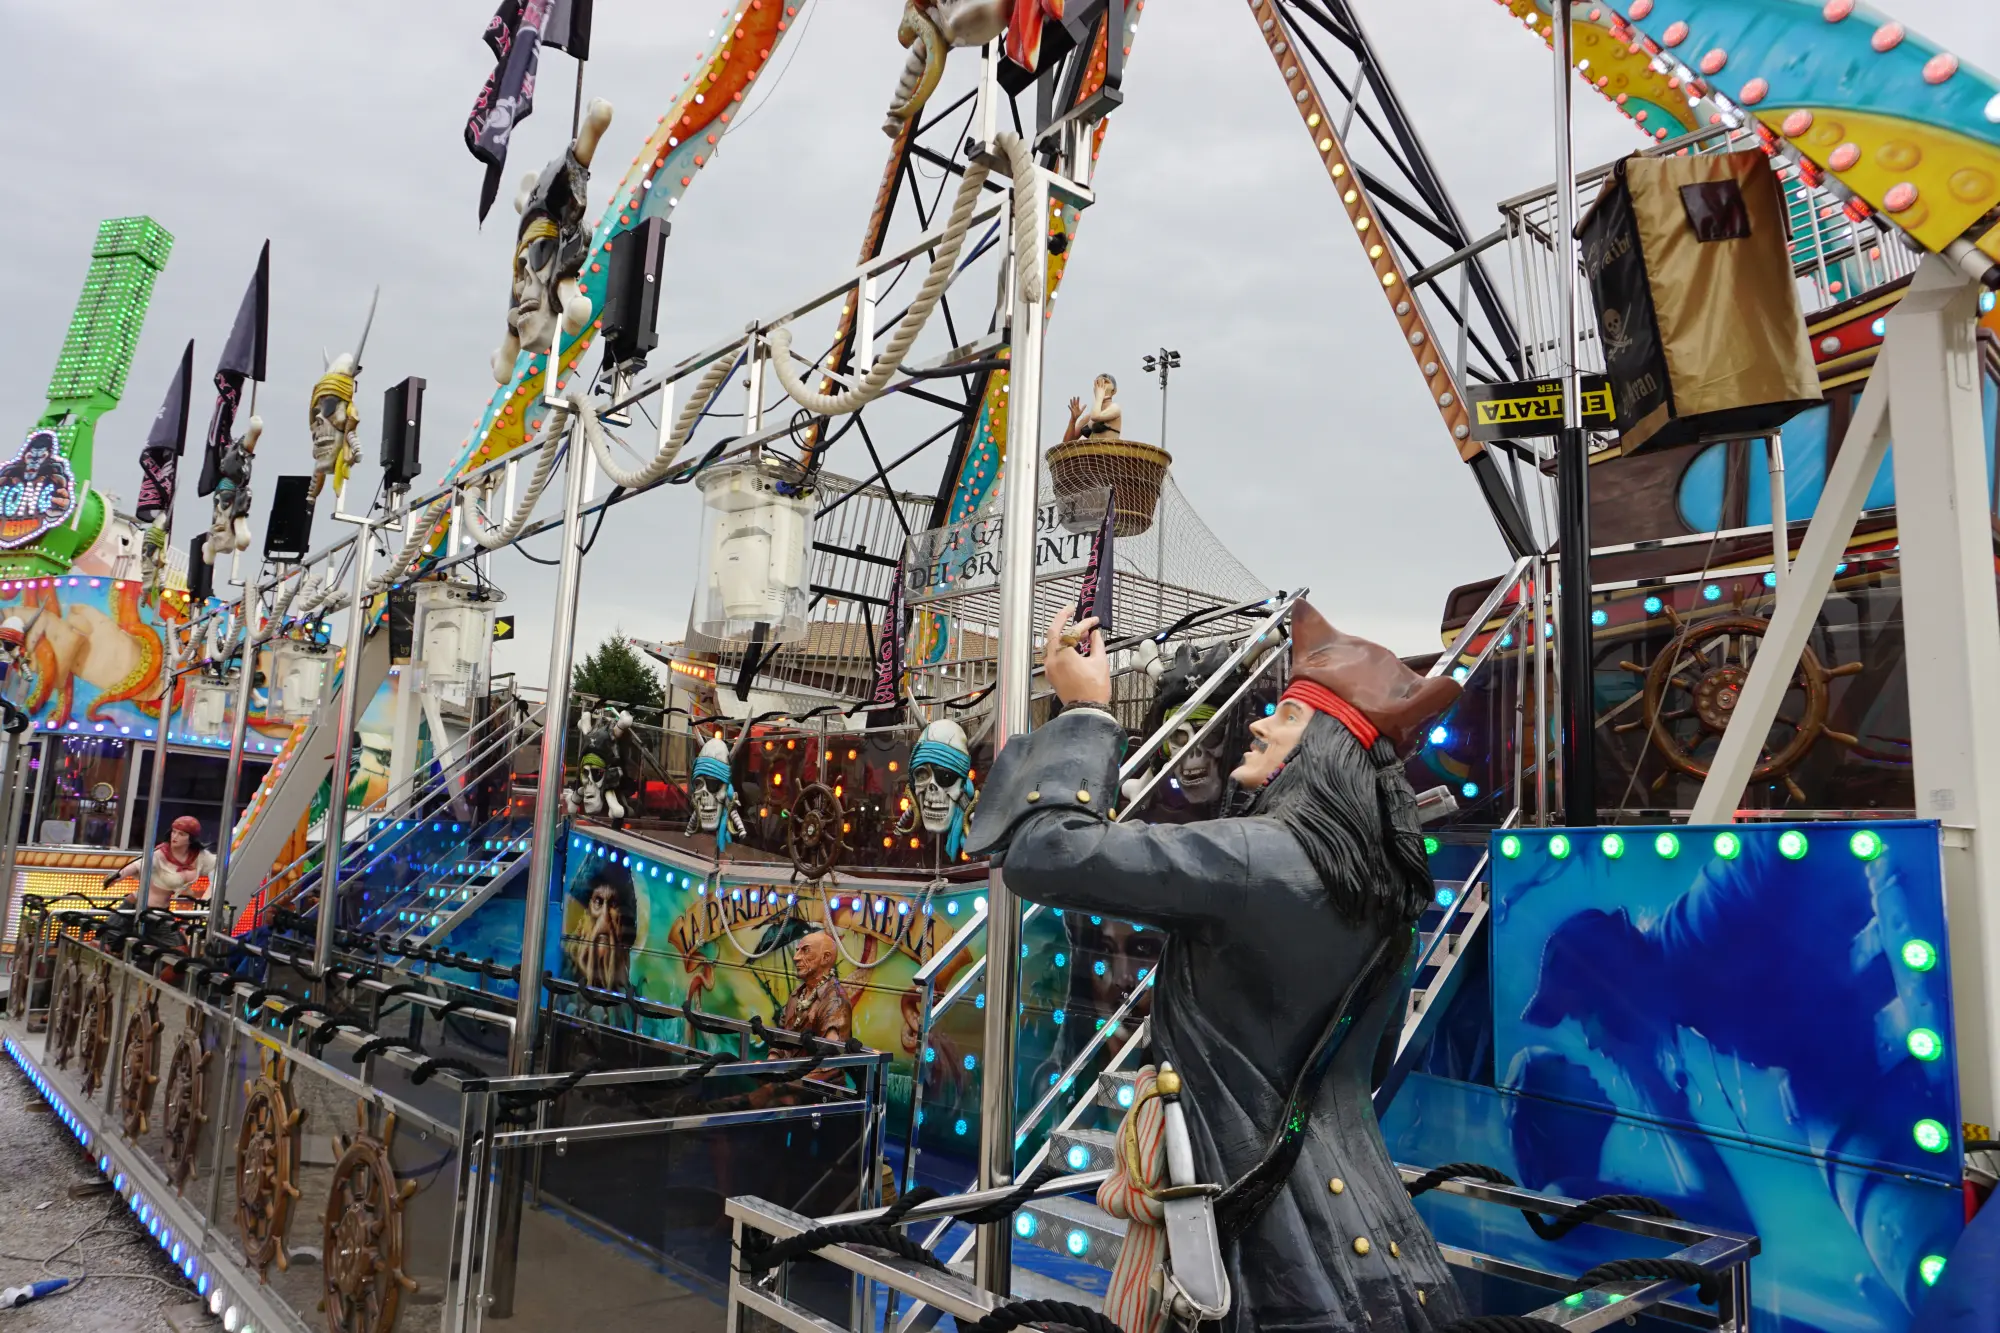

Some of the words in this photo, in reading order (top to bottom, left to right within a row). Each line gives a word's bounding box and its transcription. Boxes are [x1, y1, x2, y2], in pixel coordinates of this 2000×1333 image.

[971, 501, 1078, 548] GABIA
[908, 561, 950, 590] DEI
[958, 531, 1098, 580] BRNTI
[680, 913, 701, 953] LA
[707, 886, 773, 935] PERLA
